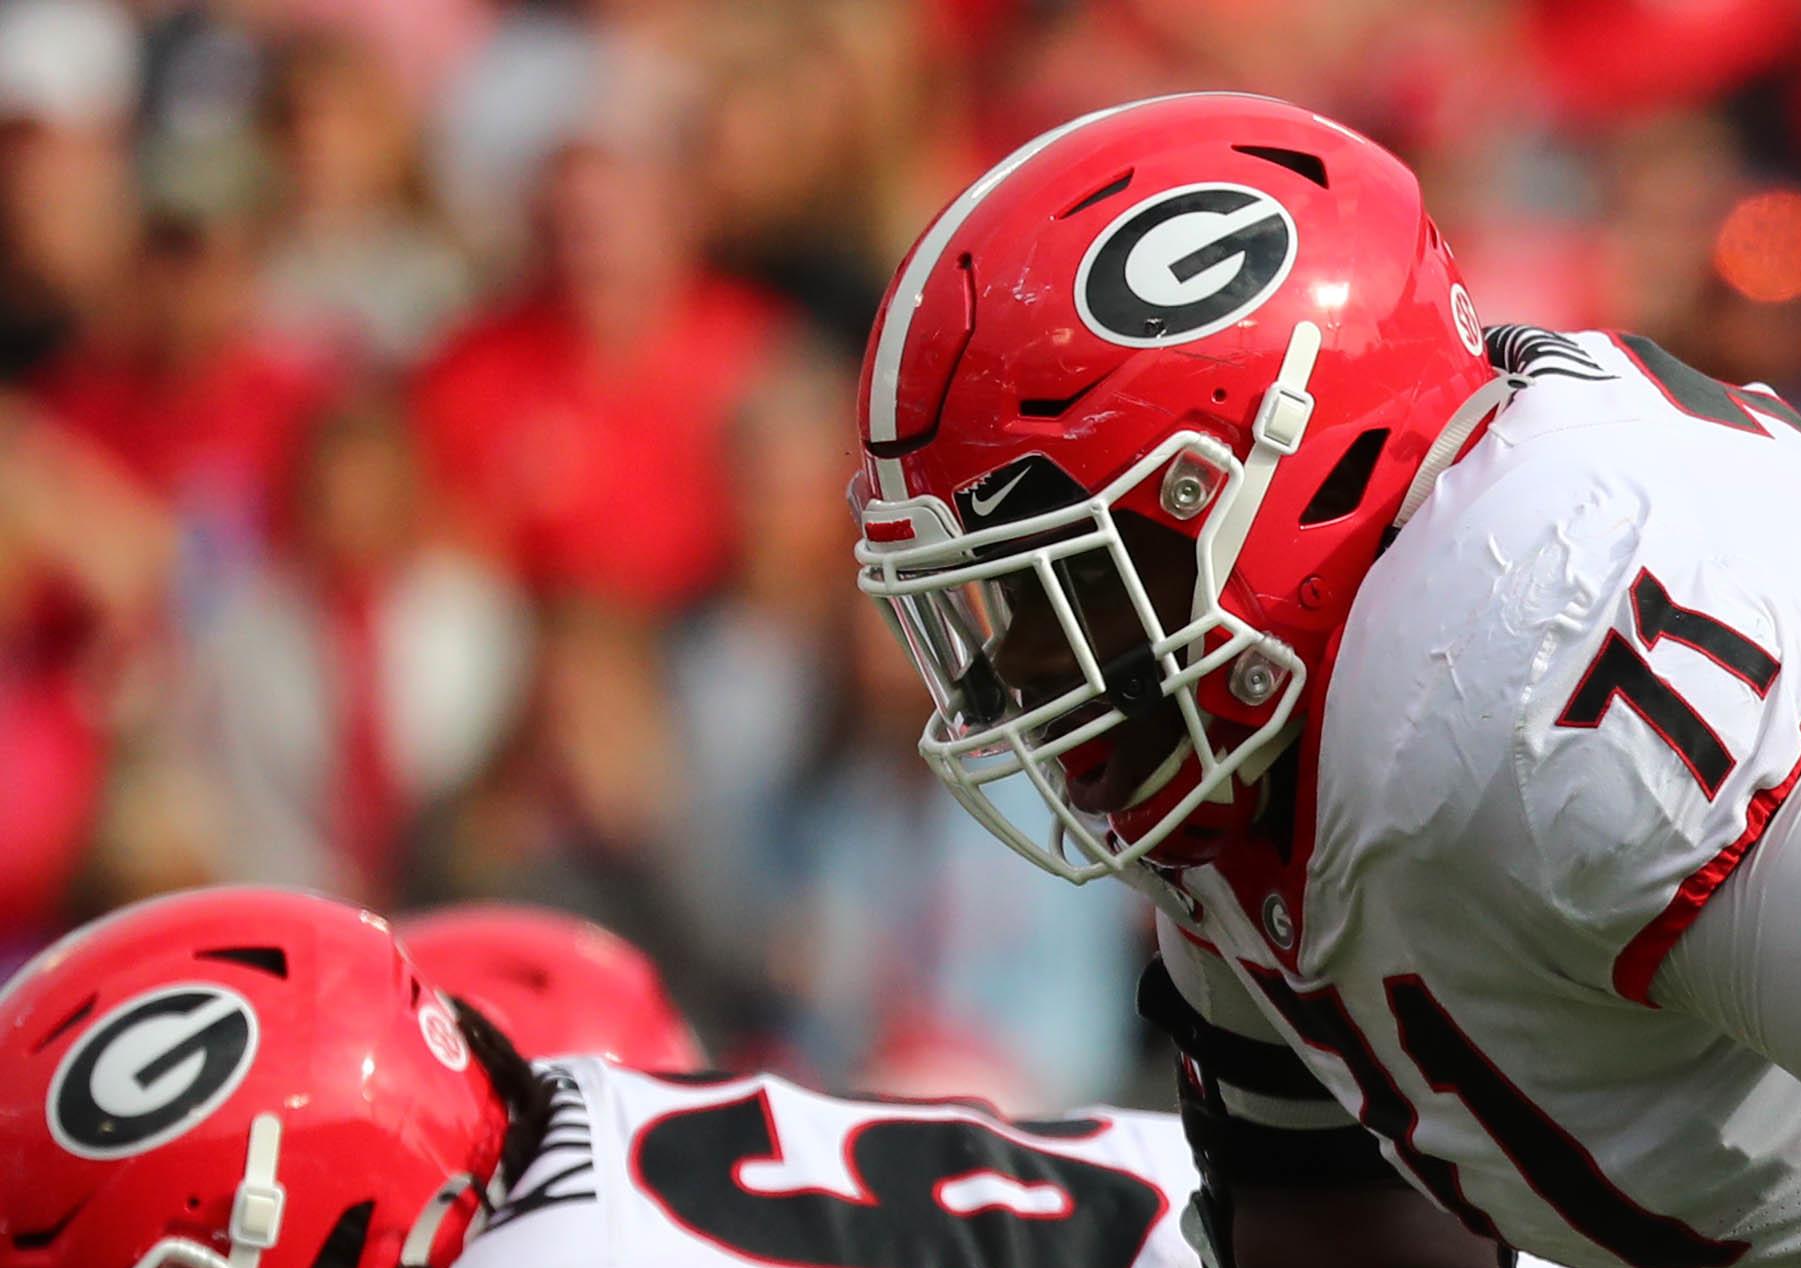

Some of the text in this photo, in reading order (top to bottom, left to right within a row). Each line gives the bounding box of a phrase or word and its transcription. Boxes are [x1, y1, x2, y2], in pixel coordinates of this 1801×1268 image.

[1080, 186, 1293, 343] G
[1554, 566, 1782, 804] 71
[1263, 893, 1295, 951] G
[52, 987, 254, 1154] G
